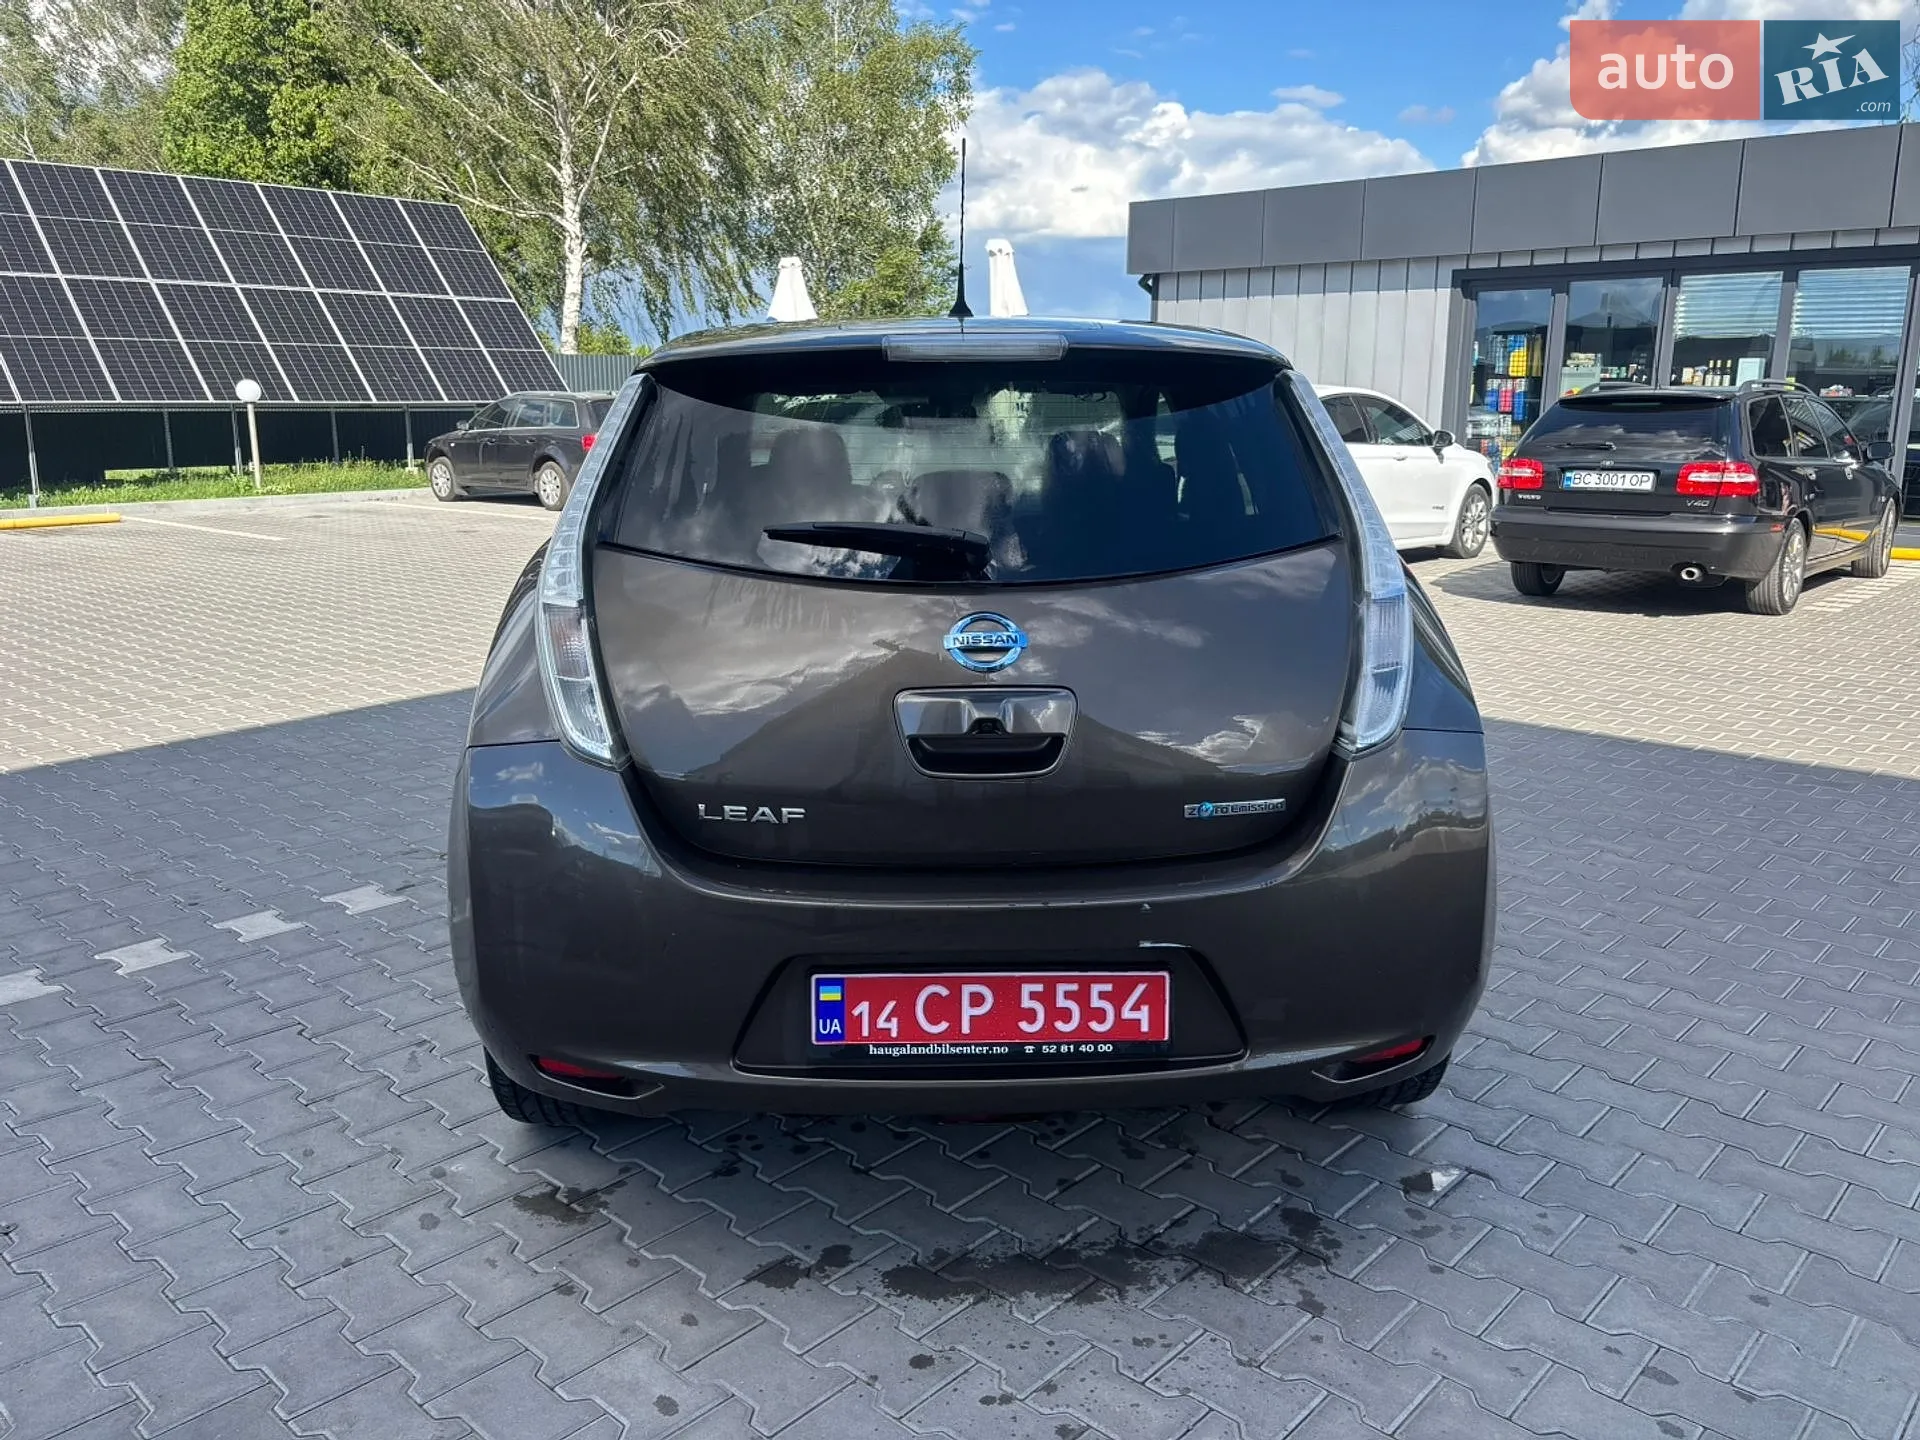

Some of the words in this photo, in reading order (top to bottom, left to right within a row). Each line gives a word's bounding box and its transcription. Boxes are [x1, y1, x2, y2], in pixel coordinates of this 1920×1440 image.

[1573, 473, 1592, 485] BC
[1594, 473, 1627, 486] 3001
[1629, 474, 1651, 487] OP
[1686, 499, 1710, 507] V40
[953, 633, 1019, 645] NISSAN
[698, 803, 806, 824] LEAF
[851, 1000, 899, 1038] 14
[914, 984, 995, 1034] CP
[1017, 982, 1150, 1033] 5554
[819, 1018, 842, 1035] UA
[869, 1044, 1009, 1056] haugalandbilsenter.no
[1042, 1045, 1056, 1053] 52
[1060, 1045, 1074, 1053] 81
[1079, 1044, 1094, 1053] 40
[1097, 1043, 1113, 1052] 00
